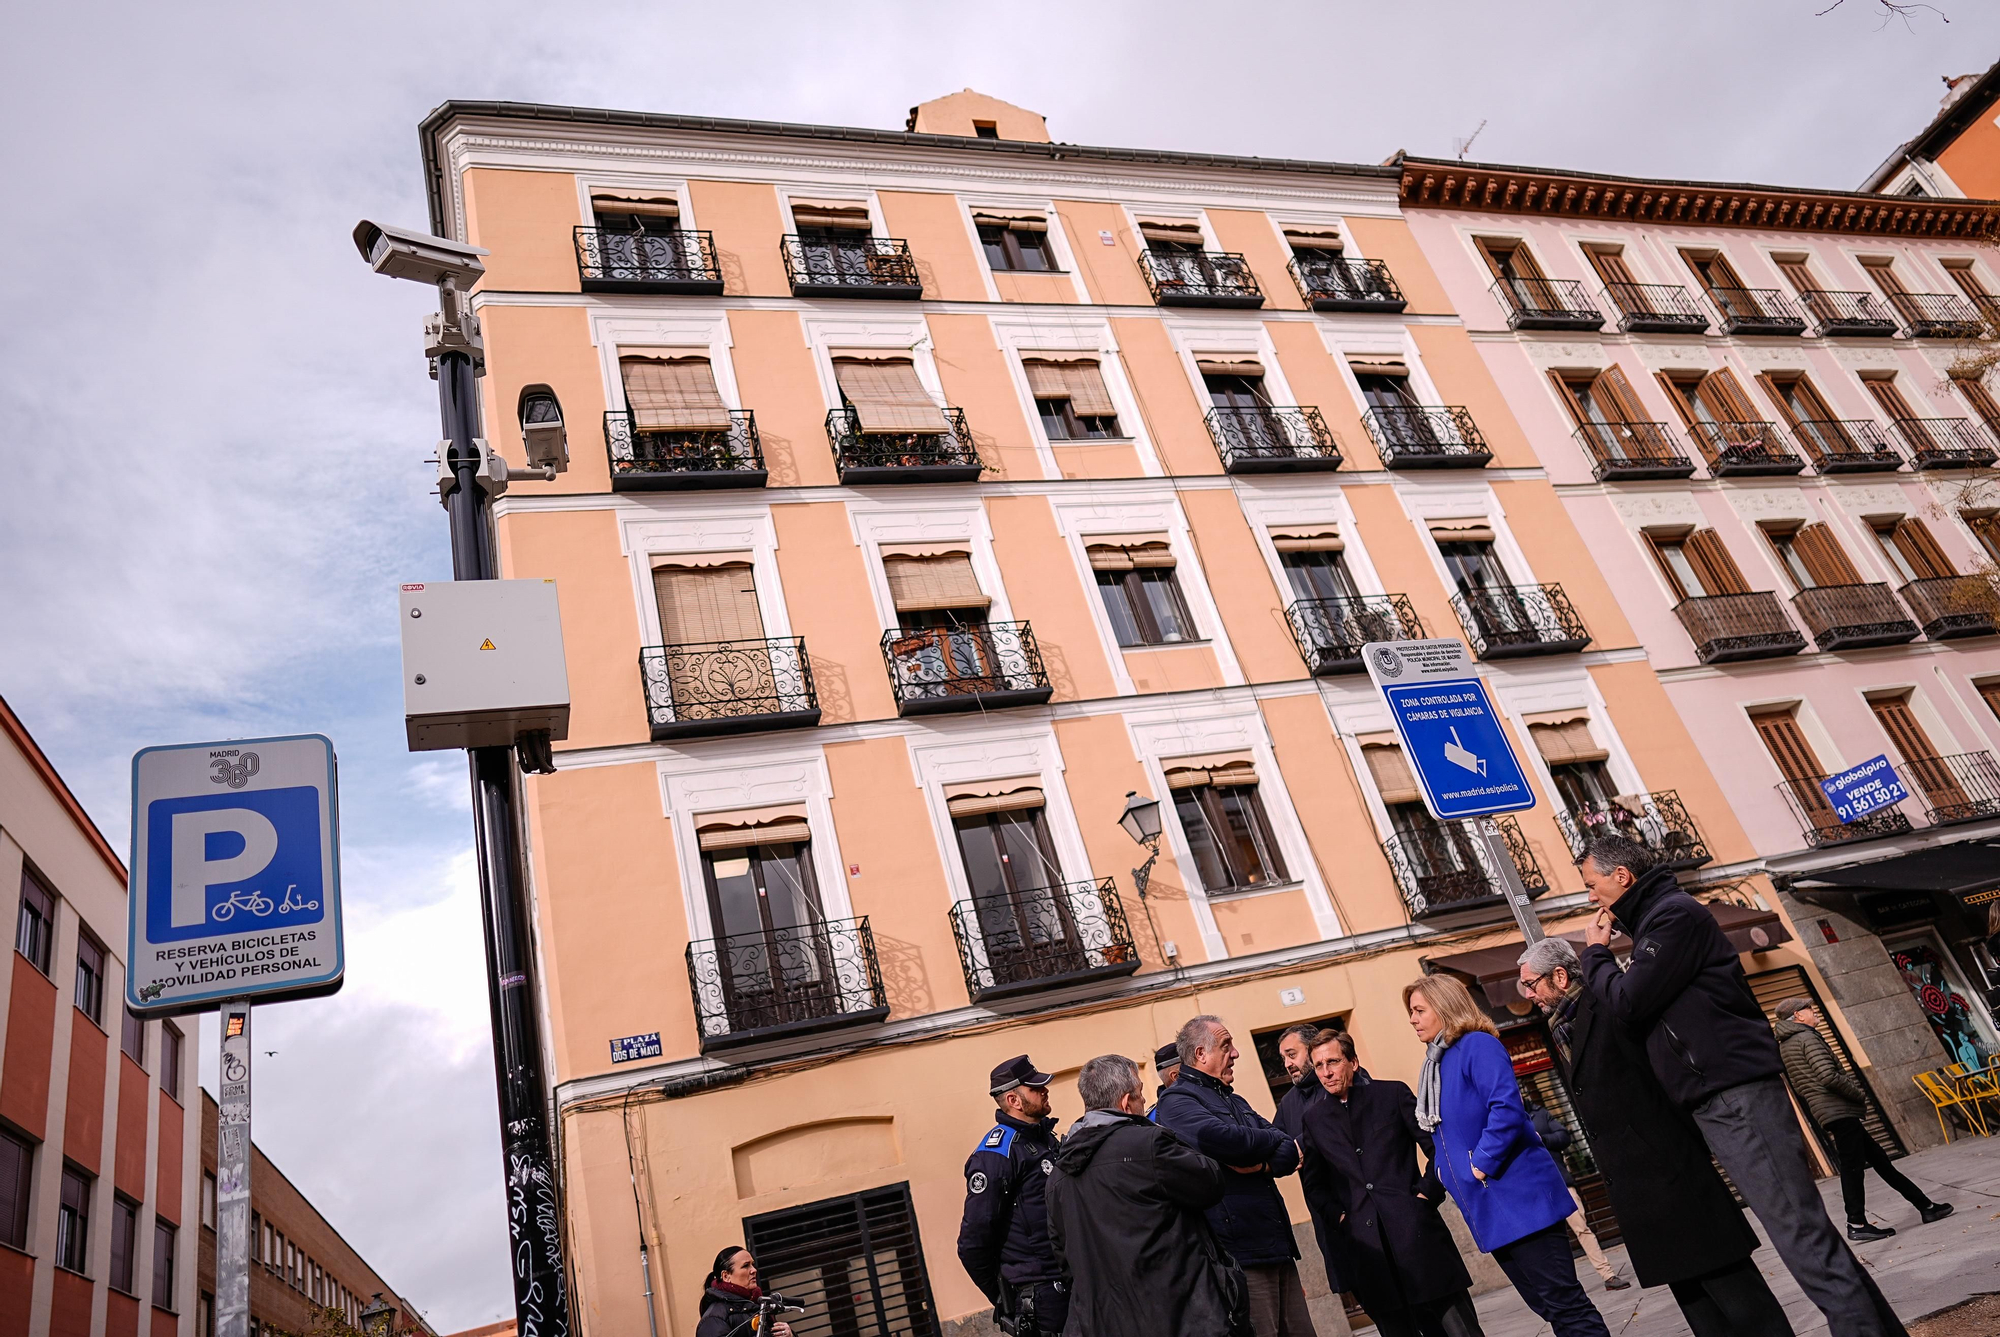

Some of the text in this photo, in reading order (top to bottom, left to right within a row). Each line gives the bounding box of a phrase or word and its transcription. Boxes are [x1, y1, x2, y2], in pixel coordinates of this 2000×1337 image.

[1401, 693, 1477, 707] ZONA CONTROLADA POR
[1407, 710, 1438, 722] CÁMARAS
[1449, 707, 1484, 718] VIGILANCIA
[210, 750, 240, 758] MADRID
[210, 752, 259, 789] 360
[1836, 760, 1886, 790] globalpiso
[1442, 783, 1518, 800] www.madrid.es/policia
[1838, 804, 1853, 819] 91
[1852, 795, 1874, 812] 561
[1874, 788, 1890, 803] 50
[1889, 781, 1905, 796] 21
[1846, 779, 1882, 800] VENDE
[171, 808, 278, 928] P
[156, 930, 316, 961] RESERVA BICICLETAS
[175, 946, 299, 972] Y VEHÍCULOS DE
[241, 957, 321, 978] PERSONAL
[1288, 992, 1296, 1001] 3
[624, 1034, 657, 1045] PLAZA
[613, 1045, 660, 1062] DOS DE MAYO
